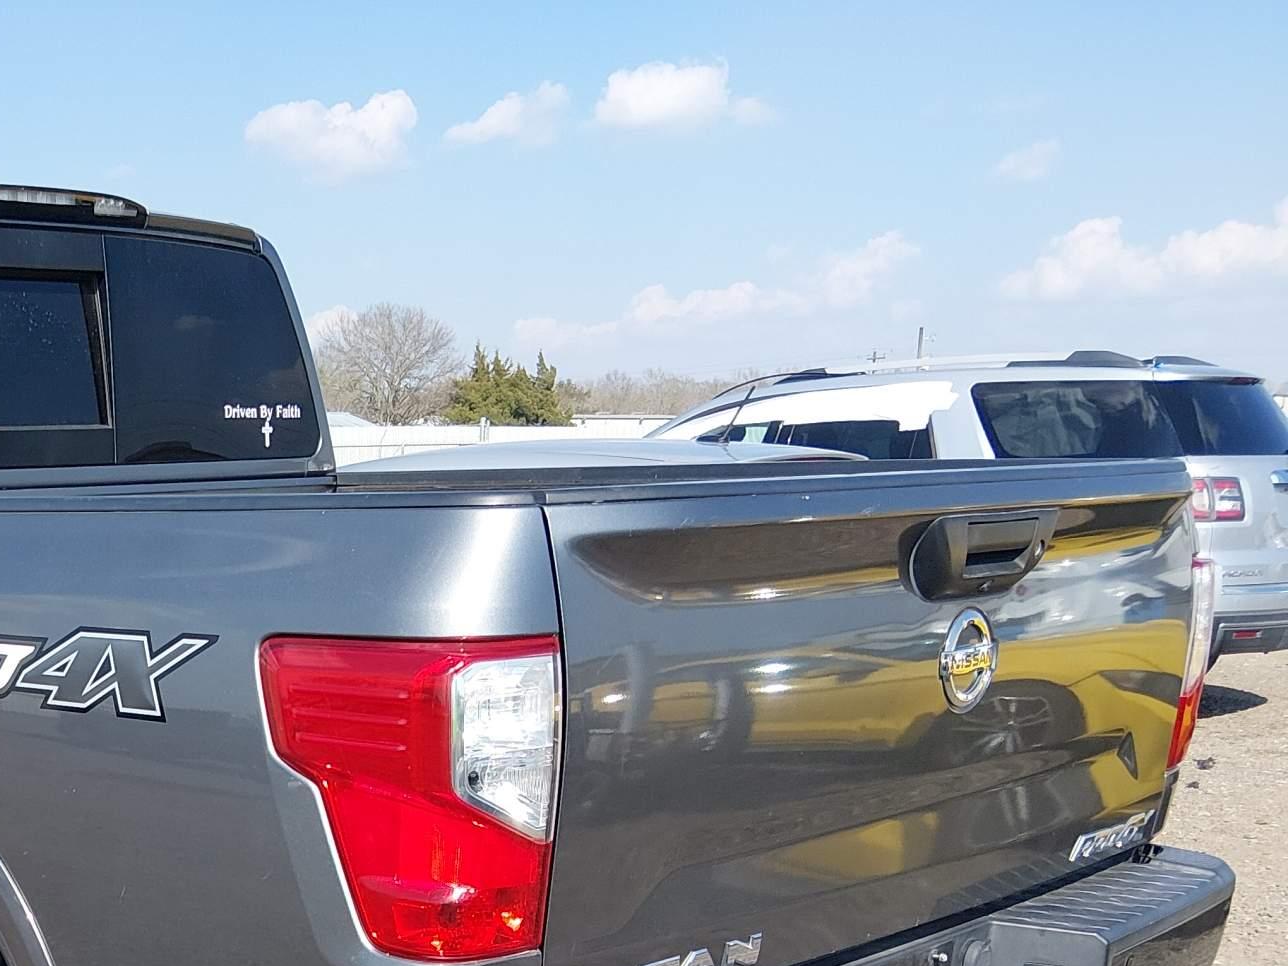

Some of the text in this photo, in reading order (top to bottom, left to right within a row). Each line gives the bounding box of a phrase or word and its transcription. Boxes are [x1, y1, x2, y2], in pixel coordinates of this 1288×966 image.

[223, 403, 302, 422] Driven By Faith
